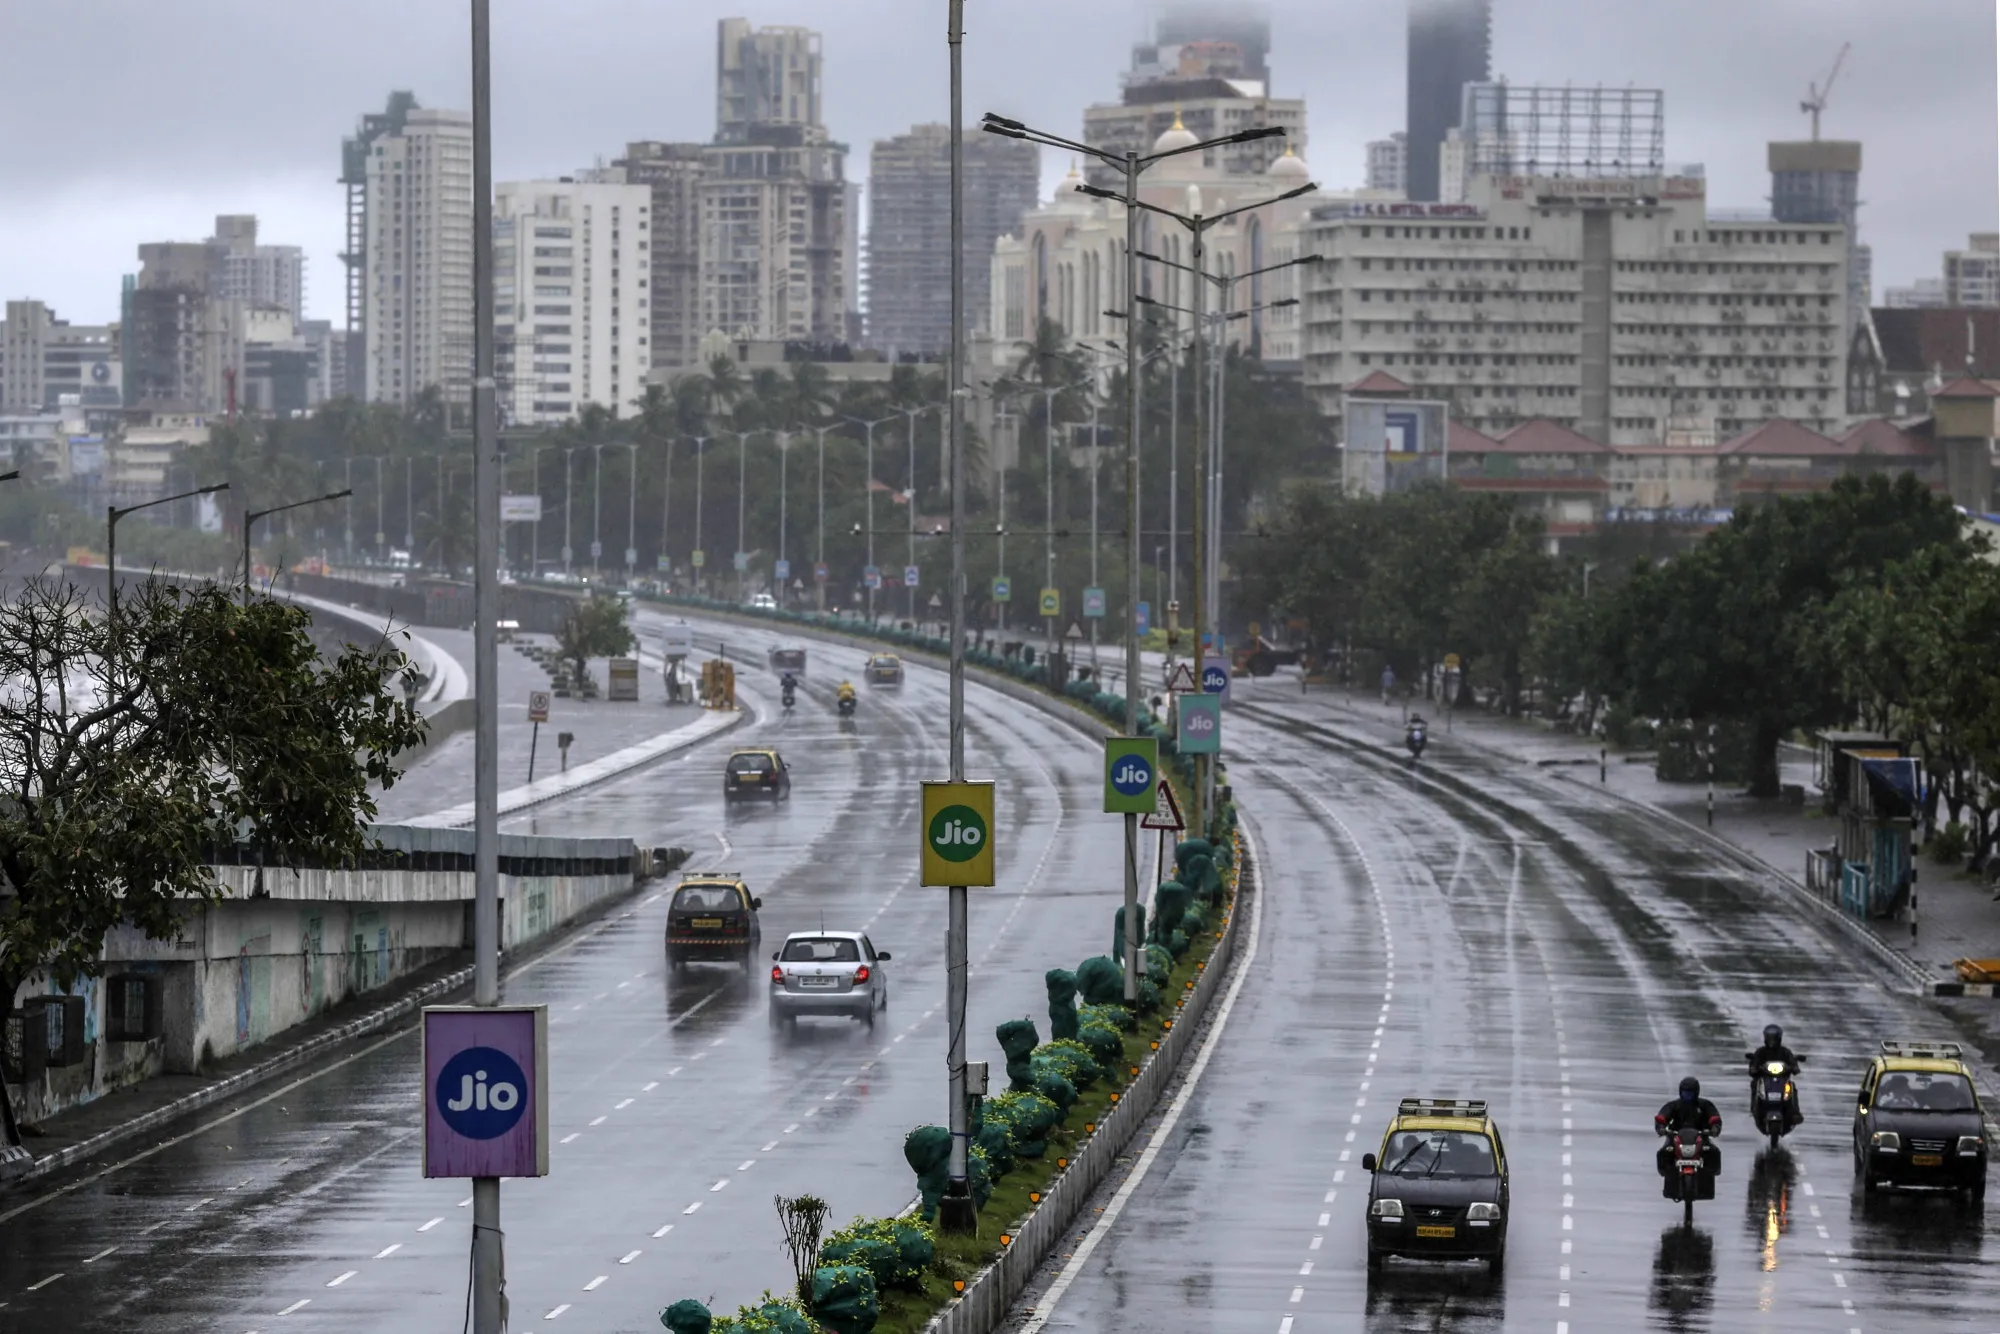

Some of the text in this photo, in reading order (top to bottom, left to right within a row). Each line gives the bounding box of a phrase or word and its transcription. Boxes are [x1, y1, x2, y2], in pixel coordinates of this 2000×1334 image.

[1203, 673, 1225, 686] Jio
[1187, 715, 1214, 731] Jio
[1115, 764, 1148, 784] Jio
[935, 819, 981, 845] Jio
[447, 1070, 519, 1112] Jio
